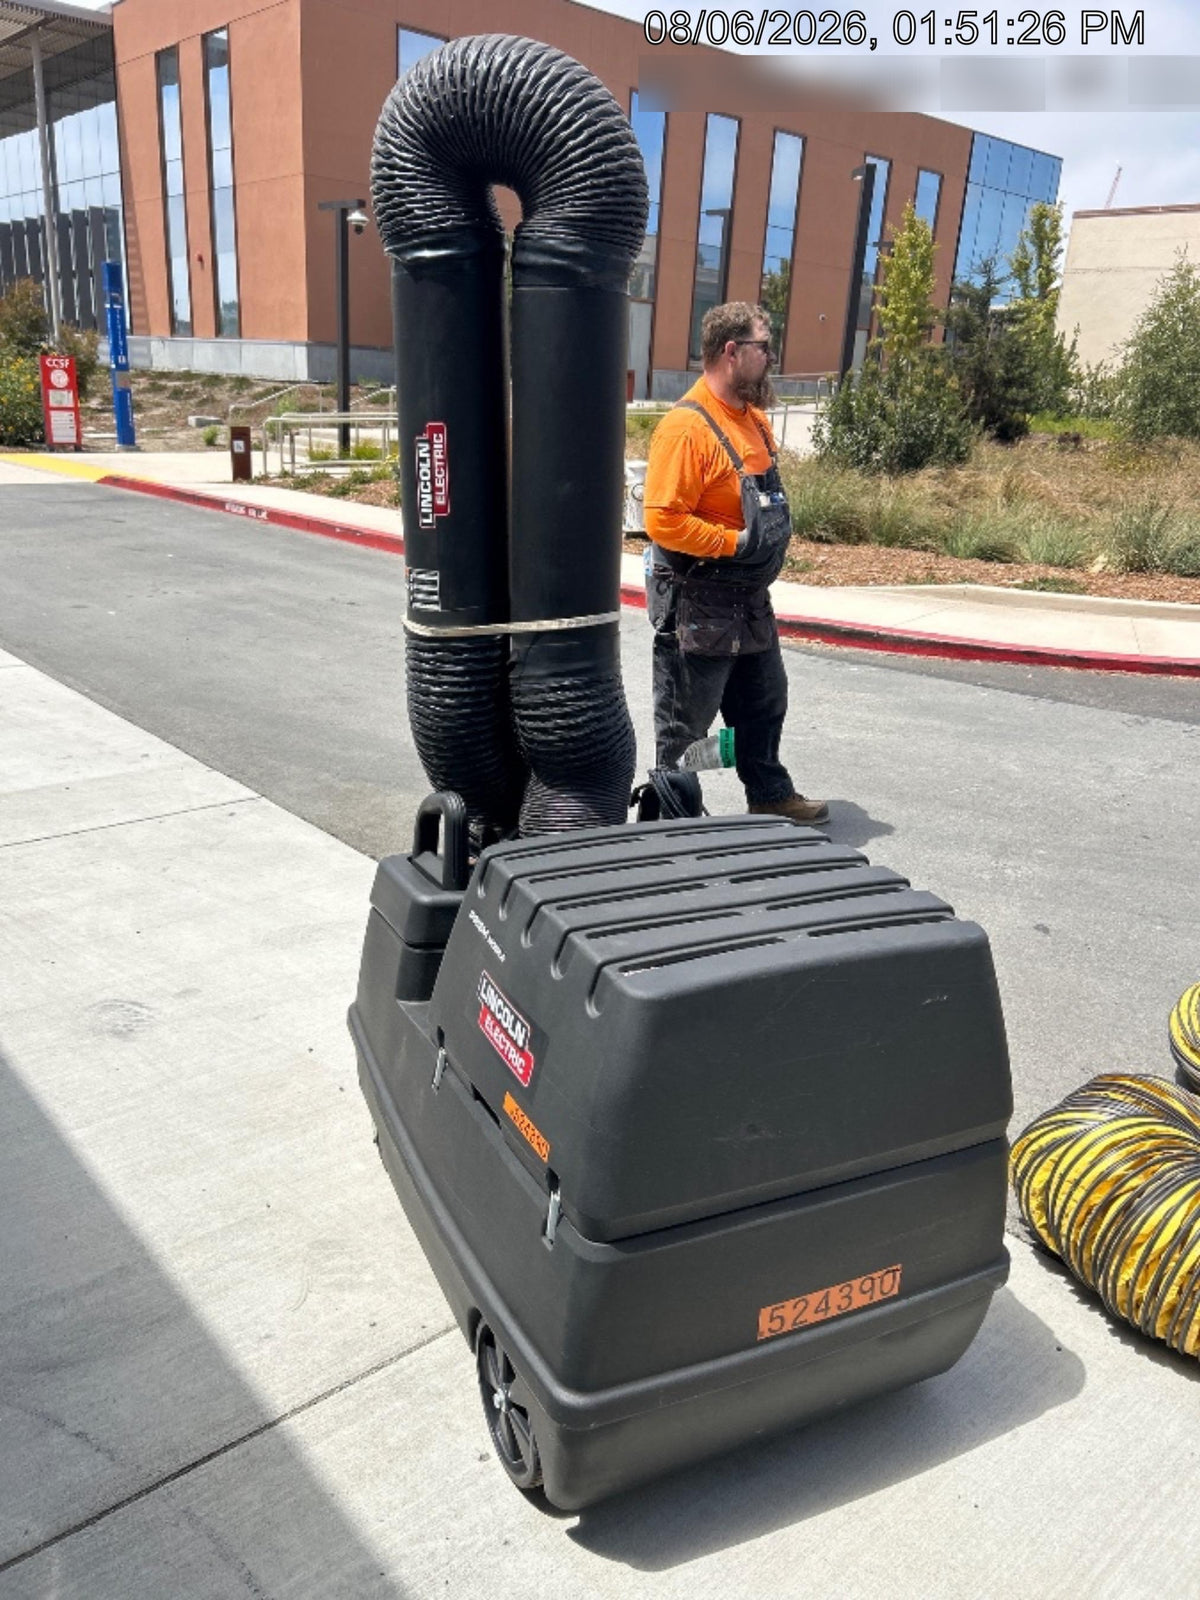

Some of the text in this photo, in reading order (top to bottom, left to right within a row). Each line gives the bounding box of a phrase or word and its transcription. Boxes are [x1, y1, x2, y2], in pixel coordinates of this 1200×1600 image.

[417, 442, 433, 524] LINCOLN
[433, 432, 446, 505] ELECTRIC
[480, 979, 527, 1047] LINCOLN
[484, 1014, 526, 1075] ELECTRIC
